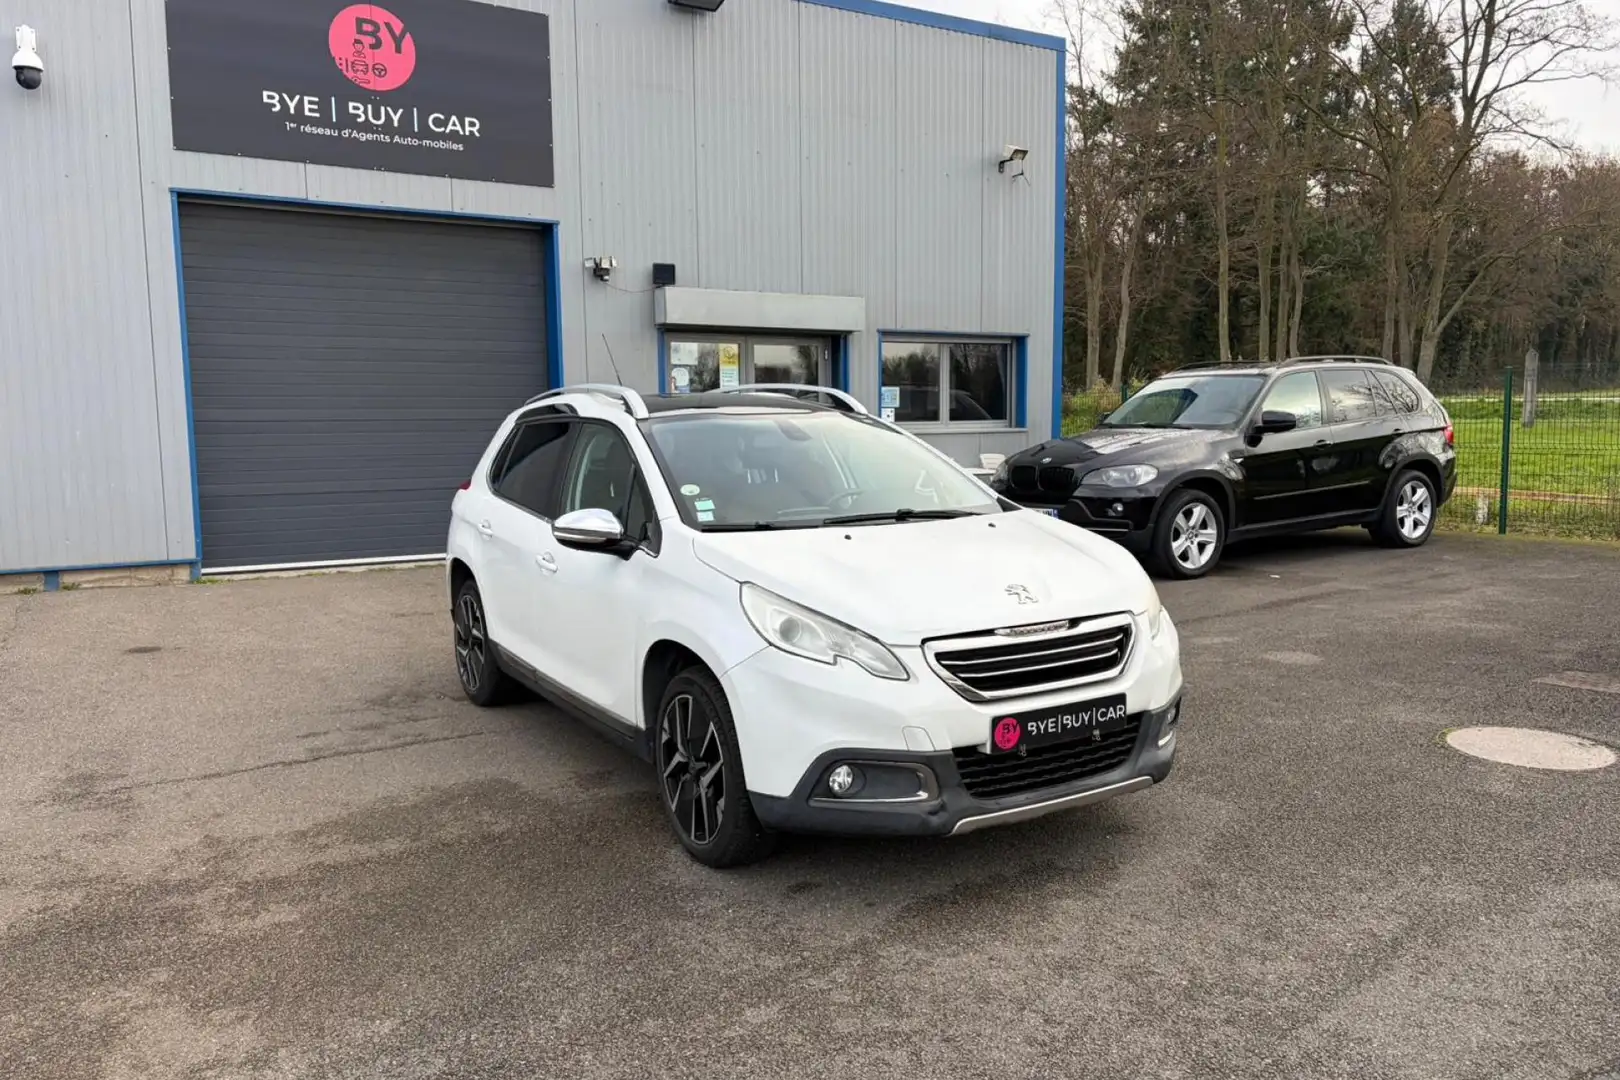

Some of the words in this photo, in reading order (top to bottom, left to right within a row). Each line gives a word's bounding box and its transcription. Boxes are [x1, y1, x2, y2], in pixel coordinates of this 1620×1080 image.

[262, 90, 321, 118] BYE
[428, 113, 480, 137] CAR
[300, 124, 338, 136] réseau
[341, 128, 391, 142] d'Agents
[393, 135, 464, 151] Auto-mobiles
